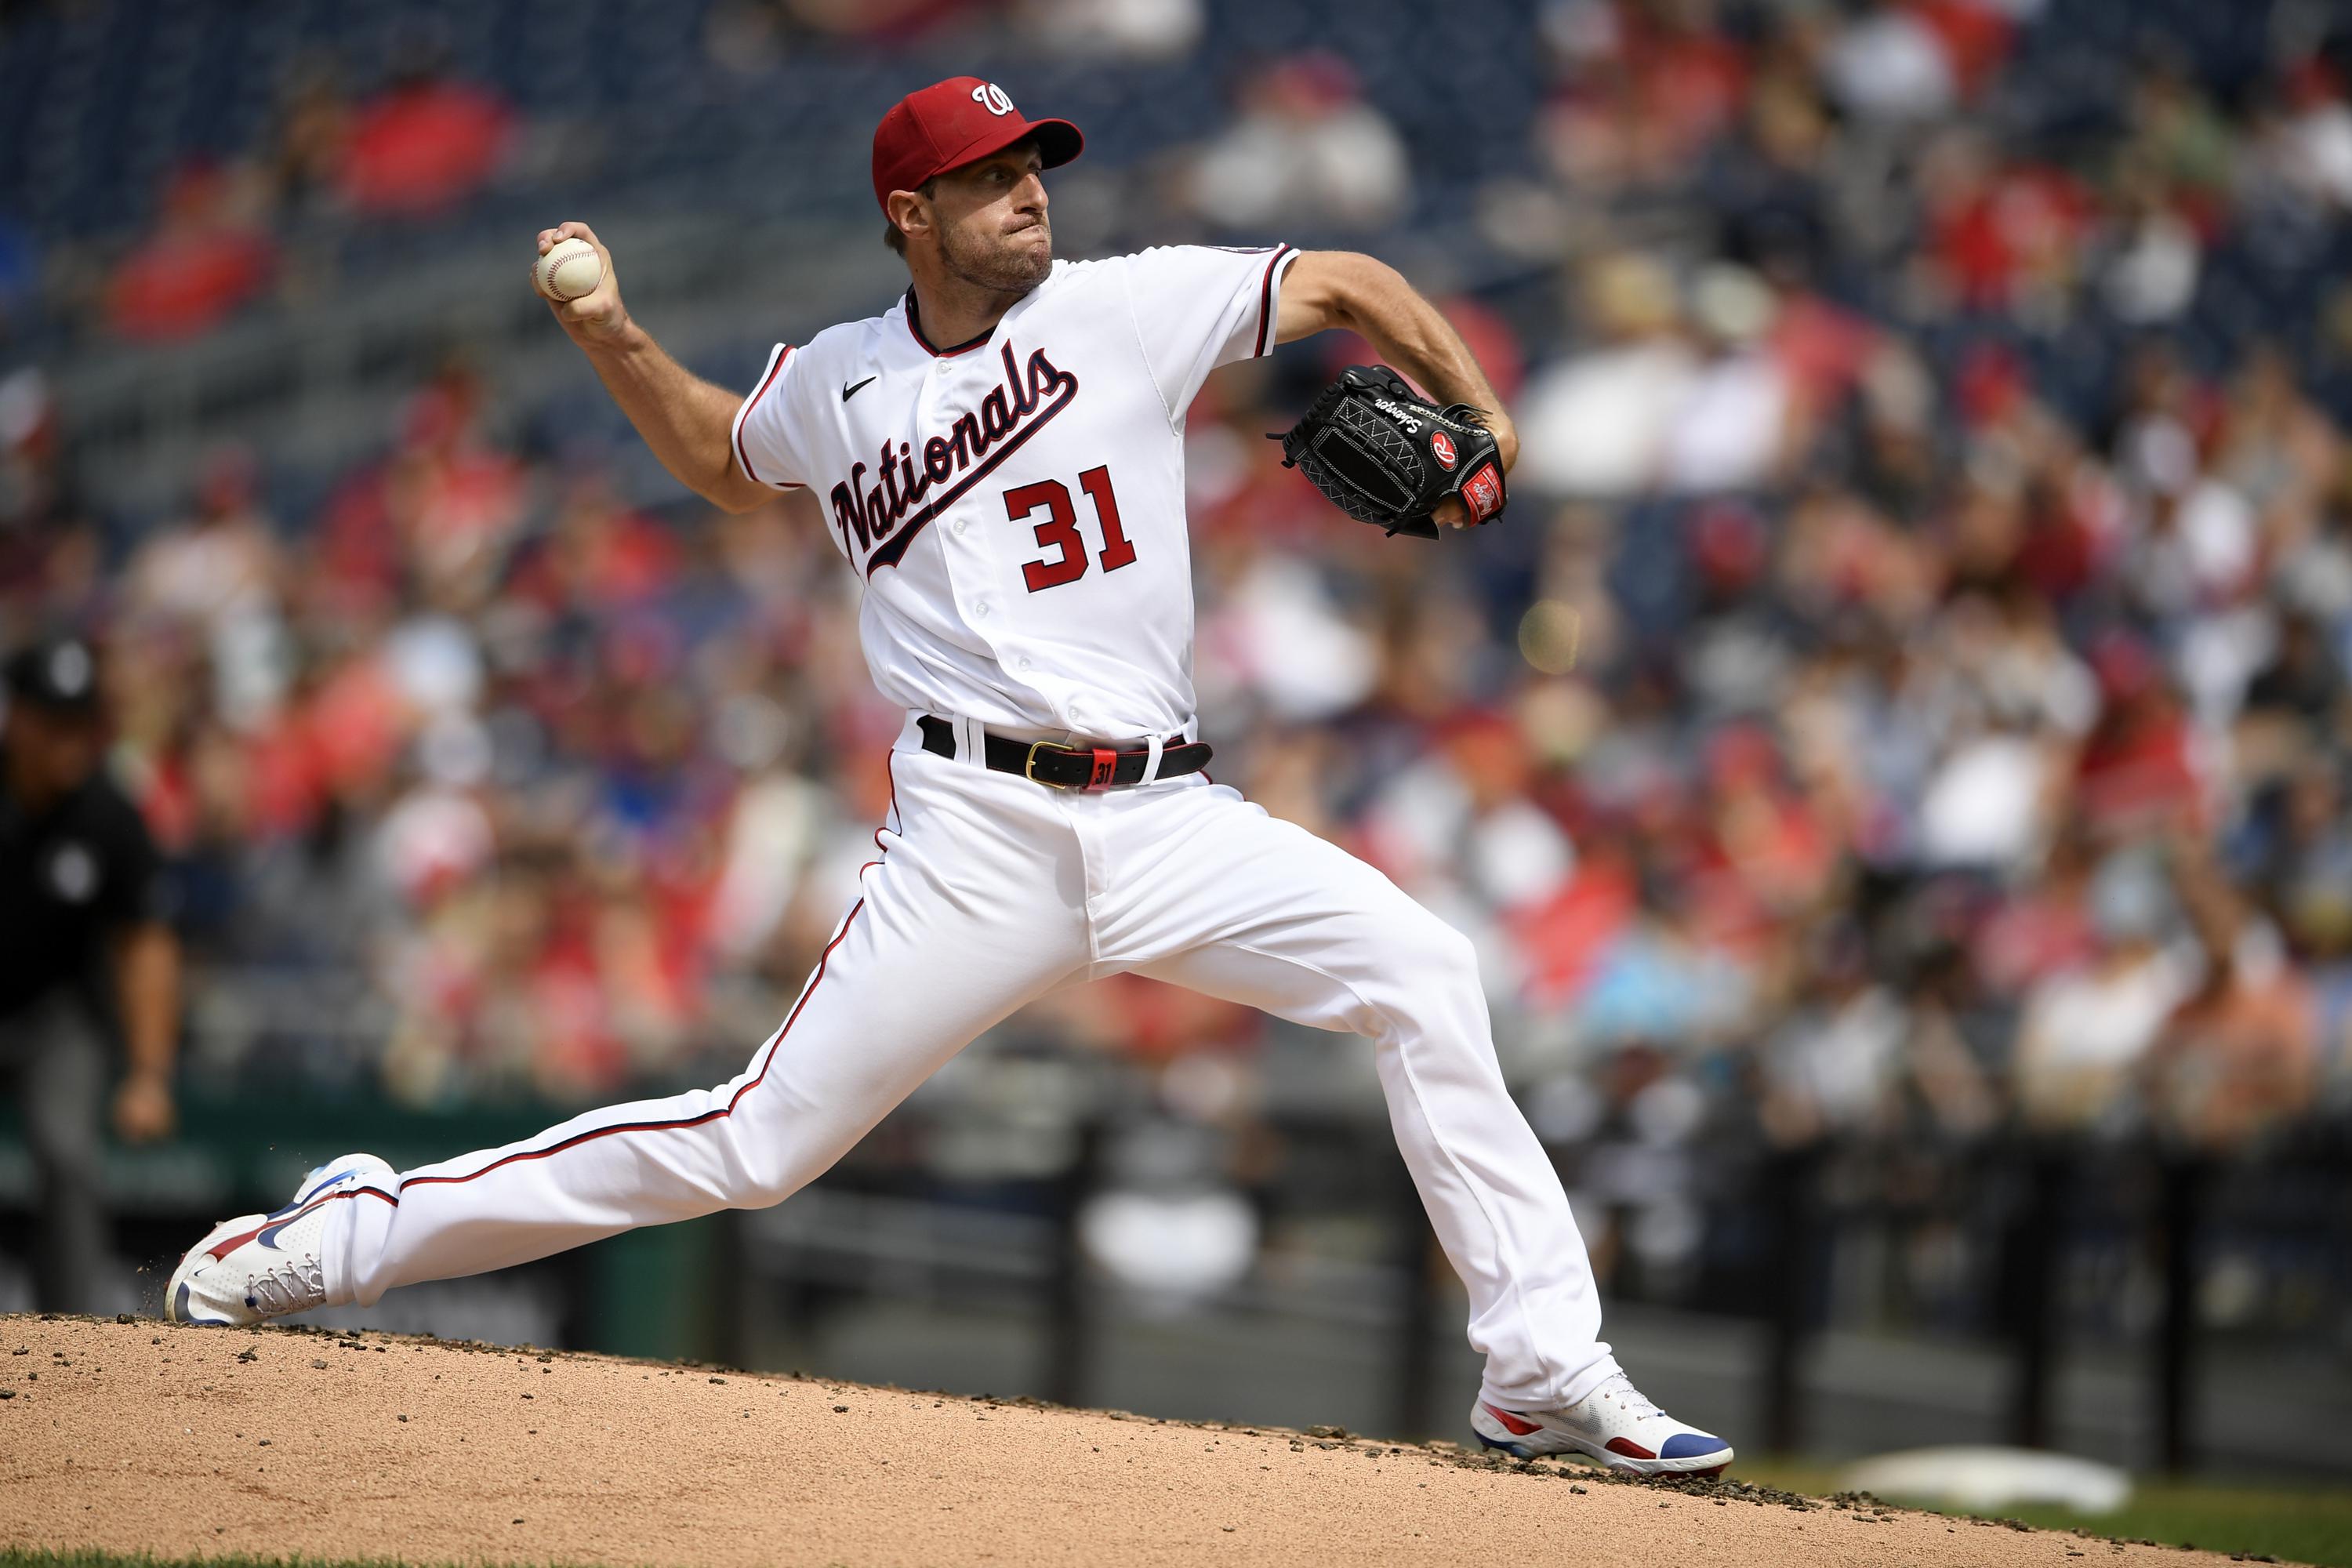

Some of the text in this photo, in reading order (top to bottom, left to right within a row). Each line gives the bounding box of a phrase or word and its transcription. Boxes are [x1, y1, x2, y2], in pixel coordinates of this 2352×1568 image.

[971, 82, 1014, 116] W
[1375, 397, 1423, 434] Scherzer
[830, 338, 1079, 586] Nationals
[1003, 464, 1137, 593] 31
[1095, 761, 1112, 784] 31
